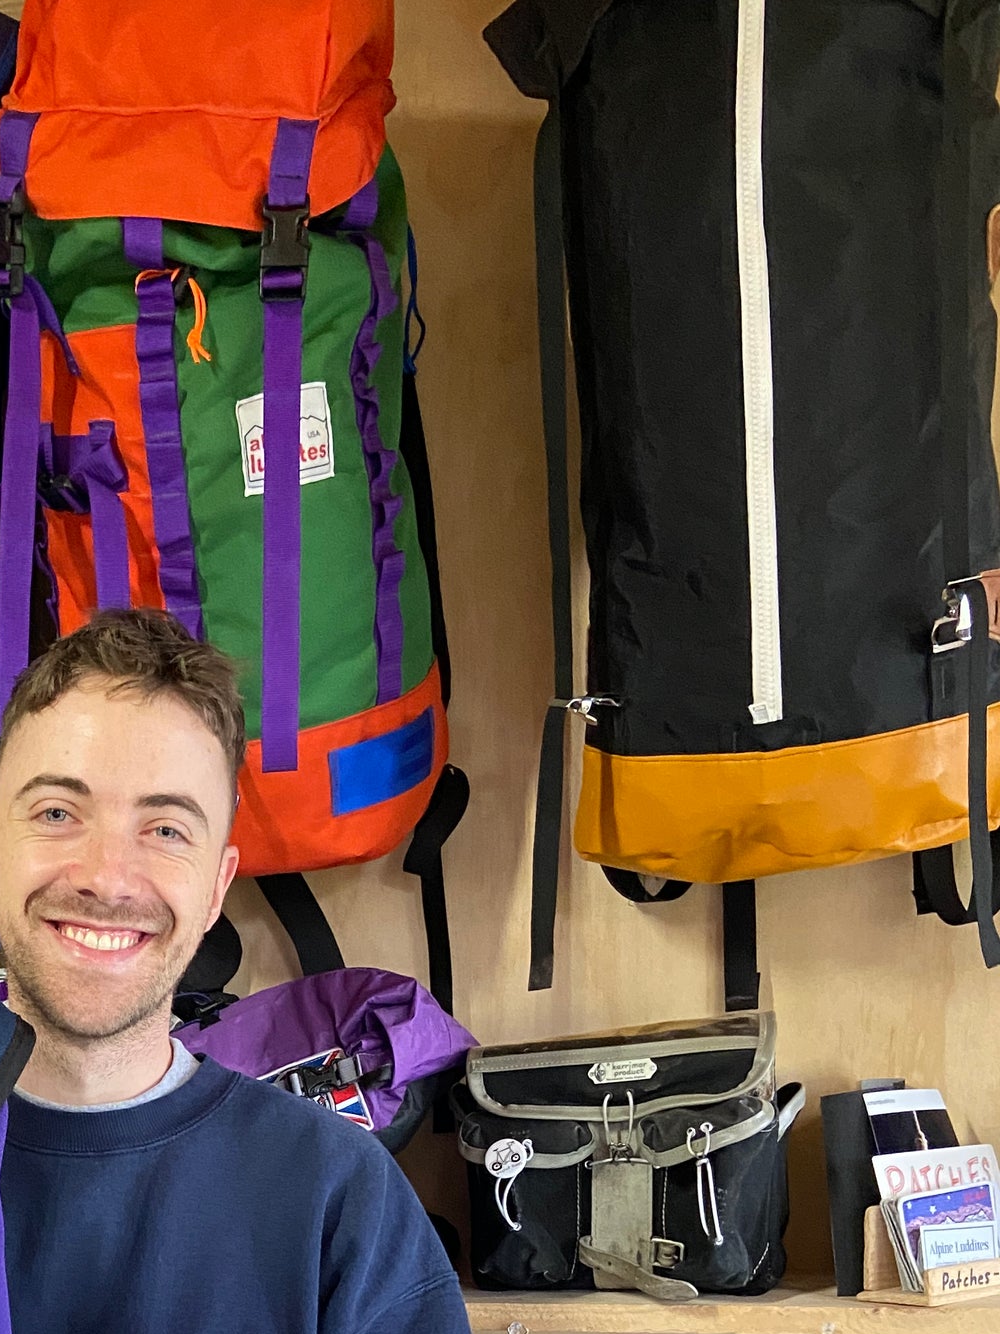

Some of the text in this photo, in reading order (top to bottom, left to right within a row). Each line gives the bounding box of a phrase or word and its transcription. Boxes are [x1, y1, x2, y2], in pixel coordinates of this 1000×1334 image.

[307, 430, 320, 438] USA
[929, 1239, 989, 1258] Alpine Luddites
